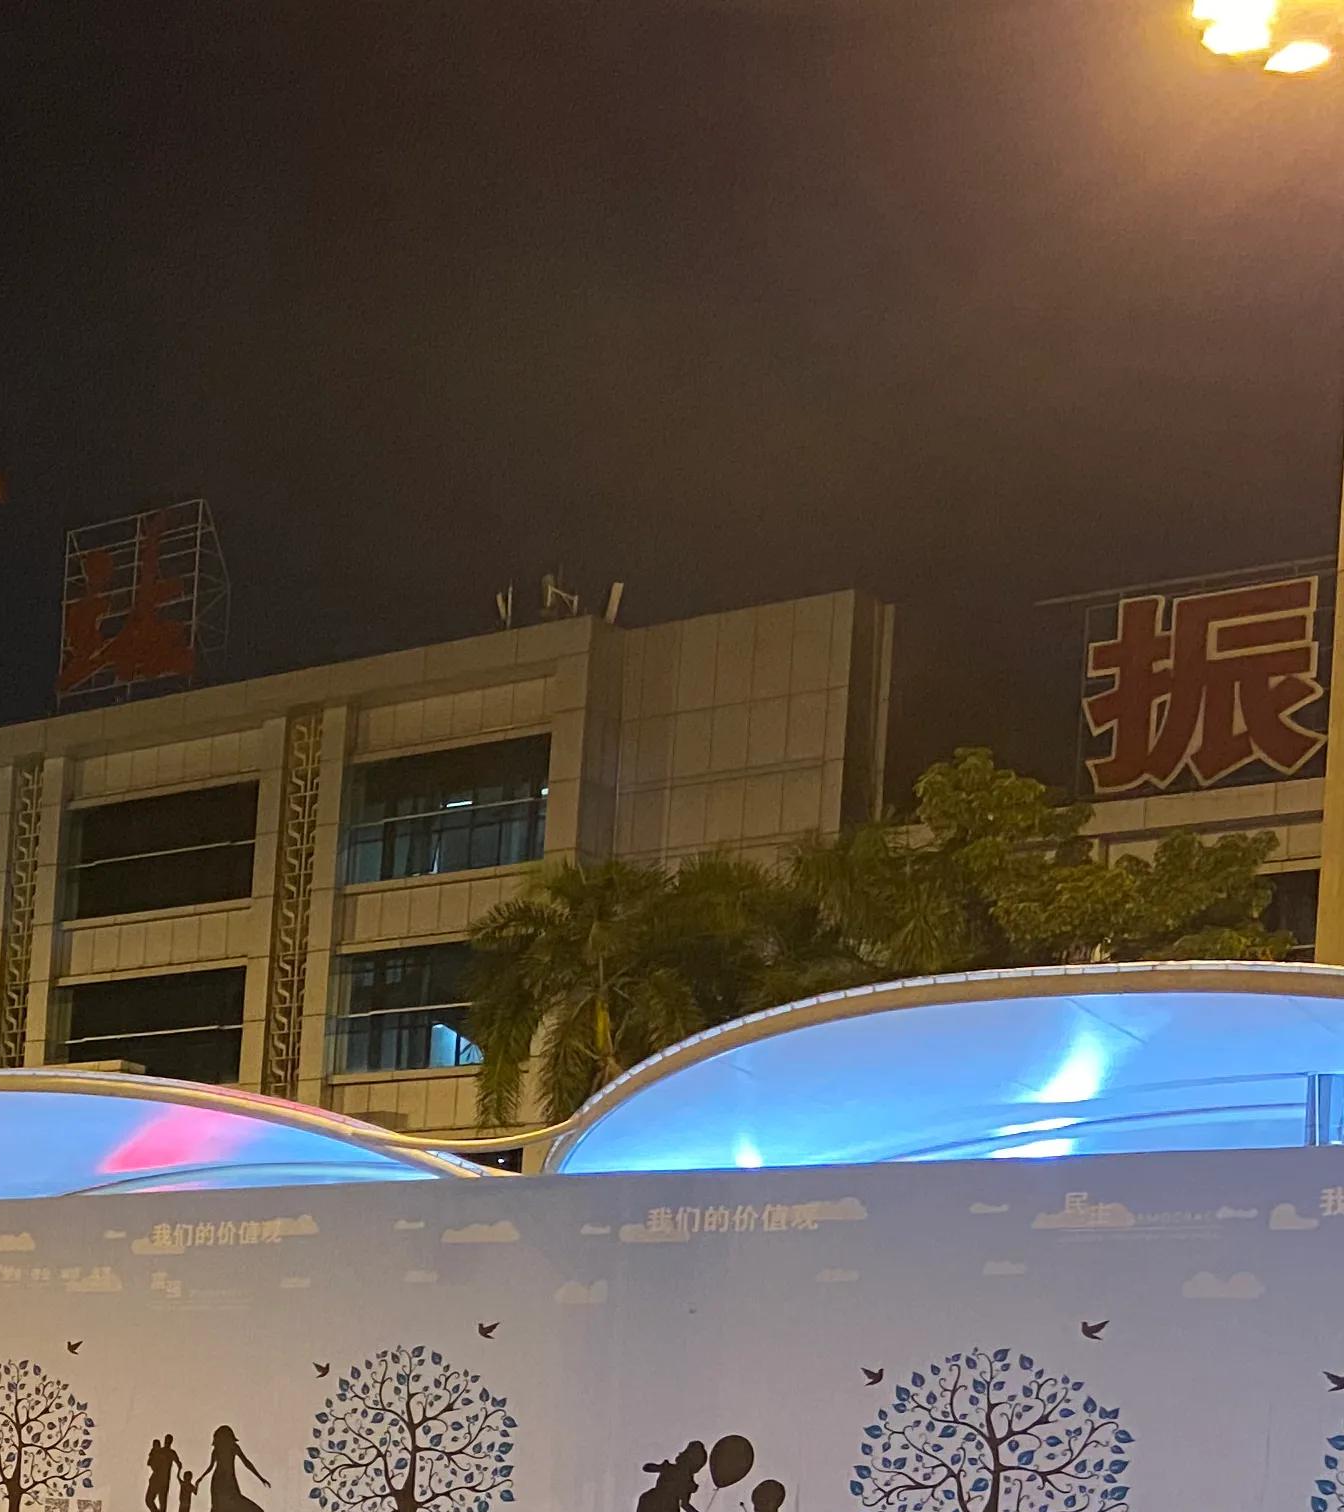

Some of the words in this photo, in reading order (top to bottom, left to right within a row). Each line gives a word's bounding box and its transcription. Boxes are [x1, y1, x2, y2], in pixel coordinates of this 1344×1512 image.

[1082, 575, 1328, 793] 振
[646, 1203, 819, 1234] 我们的价值观
